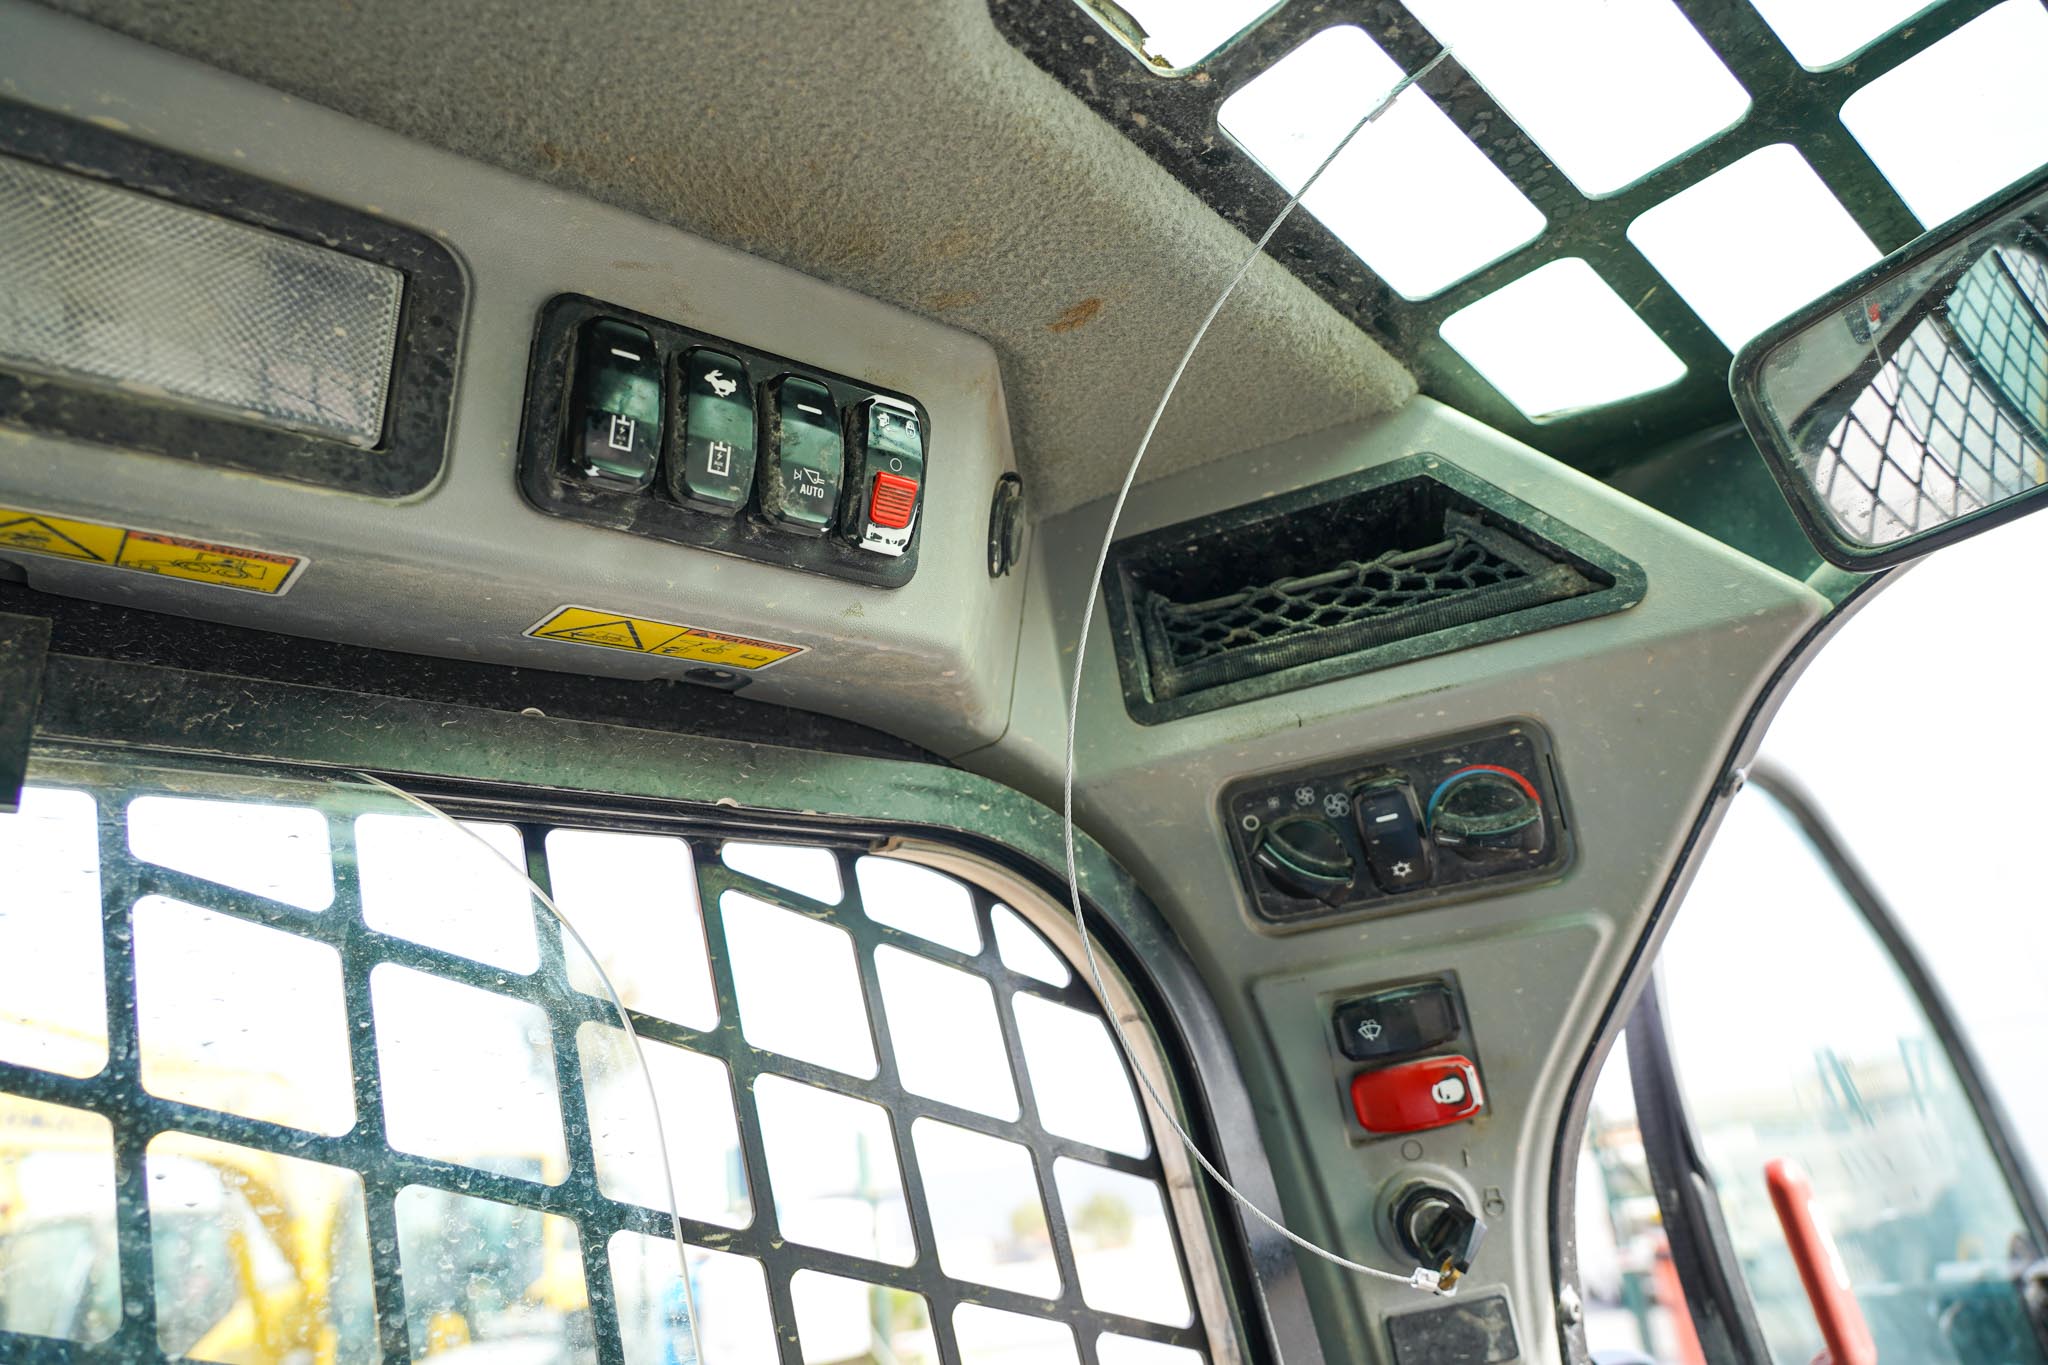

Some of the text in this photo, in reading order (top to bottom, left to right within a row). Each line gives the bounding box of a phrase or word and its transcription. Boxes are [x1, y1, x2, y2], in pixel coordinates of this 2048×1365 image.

[800, 483, 824, 499] AUTO
[172, 537, 287, 566] WARNING
[715, 635, 794, 653] WARNING
